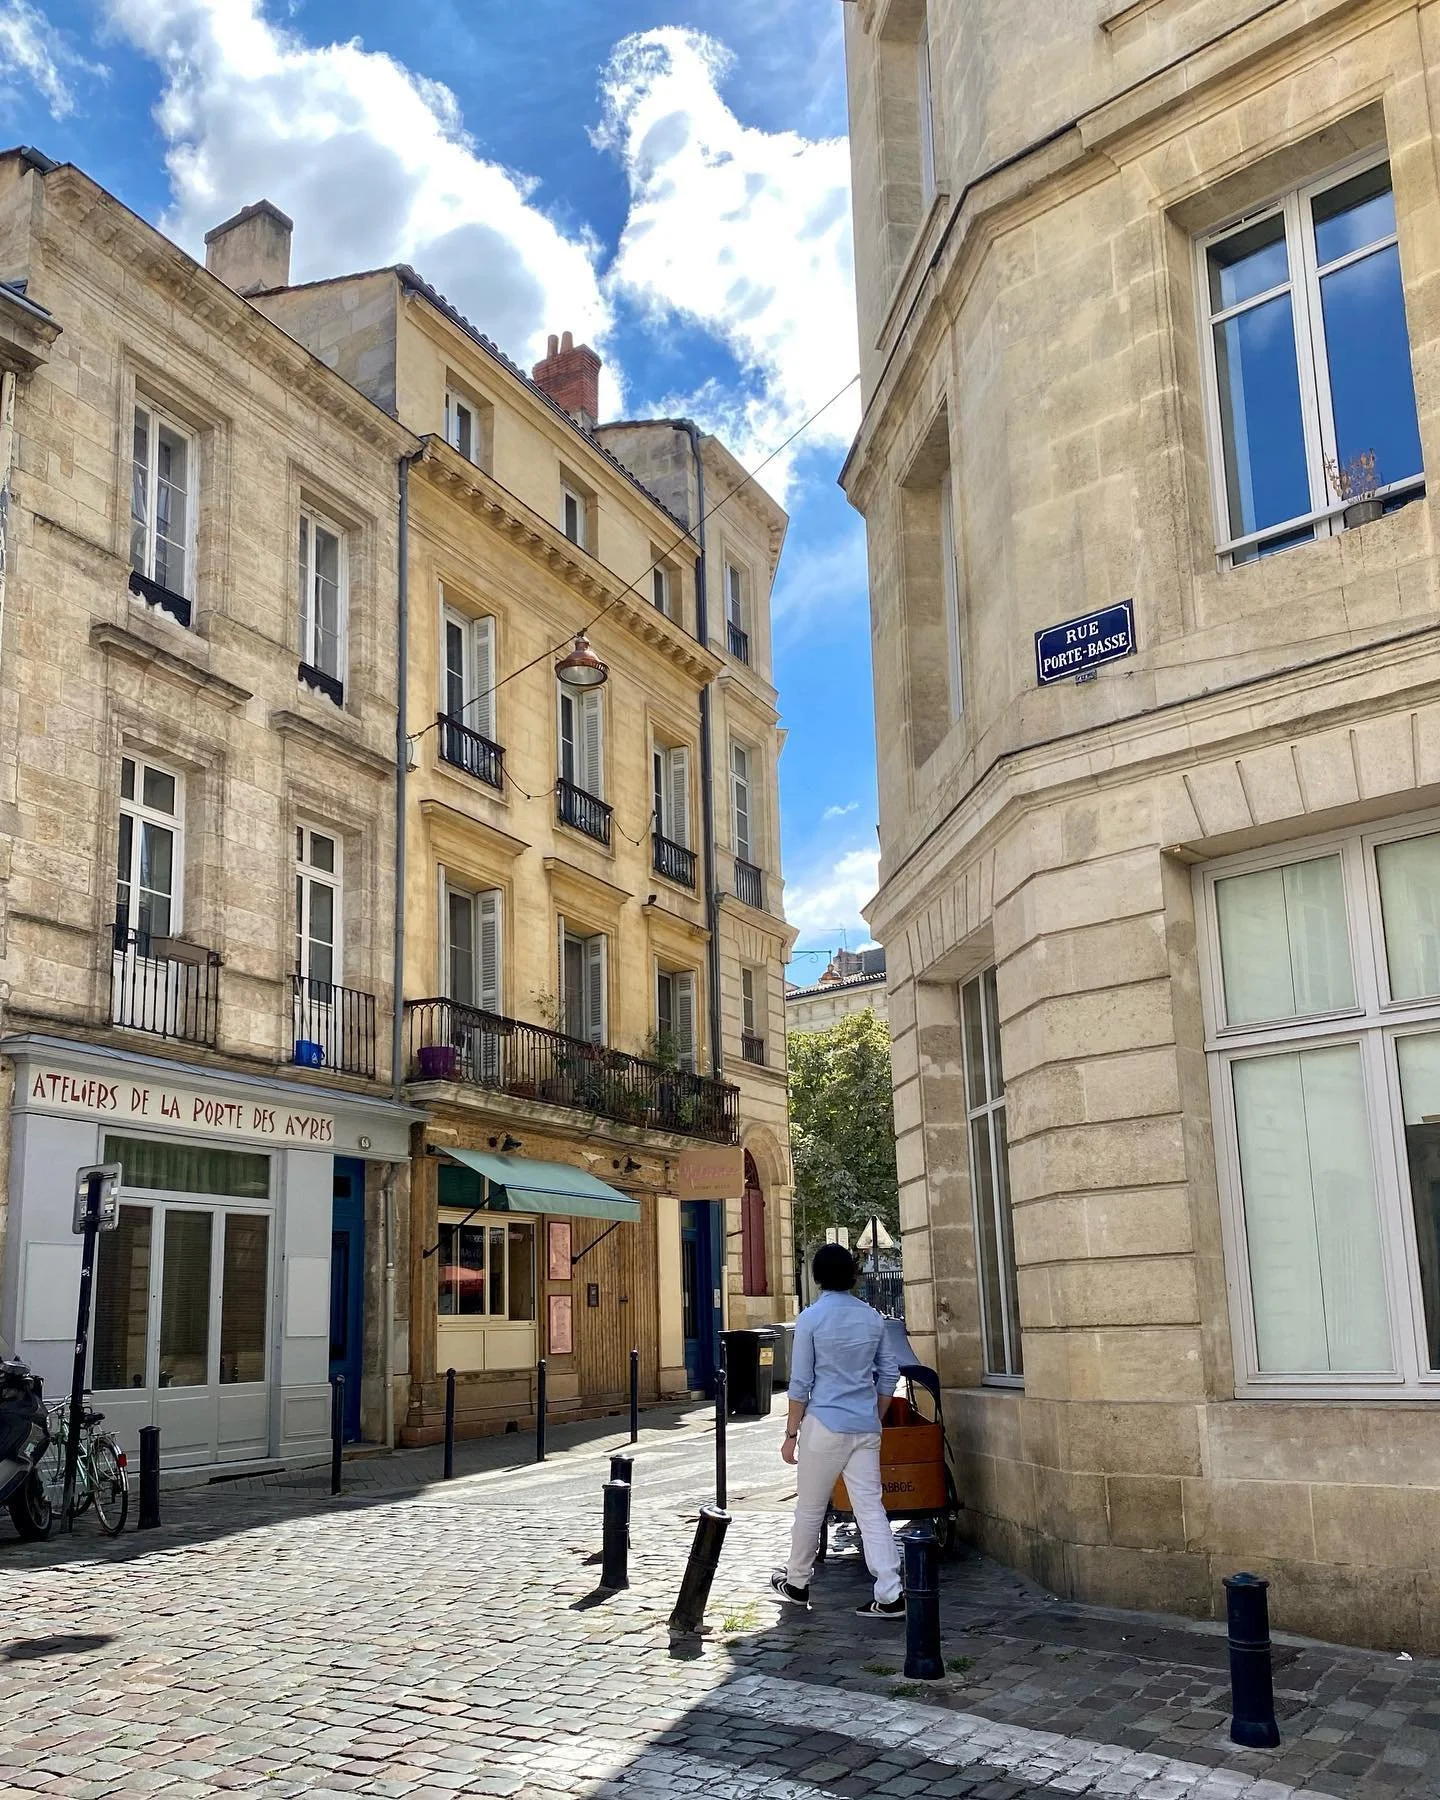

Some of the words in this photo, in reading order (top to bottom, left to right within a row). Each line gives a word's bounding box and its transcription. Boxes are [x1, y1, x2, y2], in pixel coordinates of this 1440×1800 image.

[1044, 632, 1128, 673] PORTE-BASSE
[1065, 621, 1099, 644] RUE
[131, 1087, 150, 1115] DE
[161, 1094, 181, 1119] LA
[193, 1097, 243, 1129] PORTE
[253, 1108, 276, 1133] DES
[286, 1115, 333, 1142] AYRES
